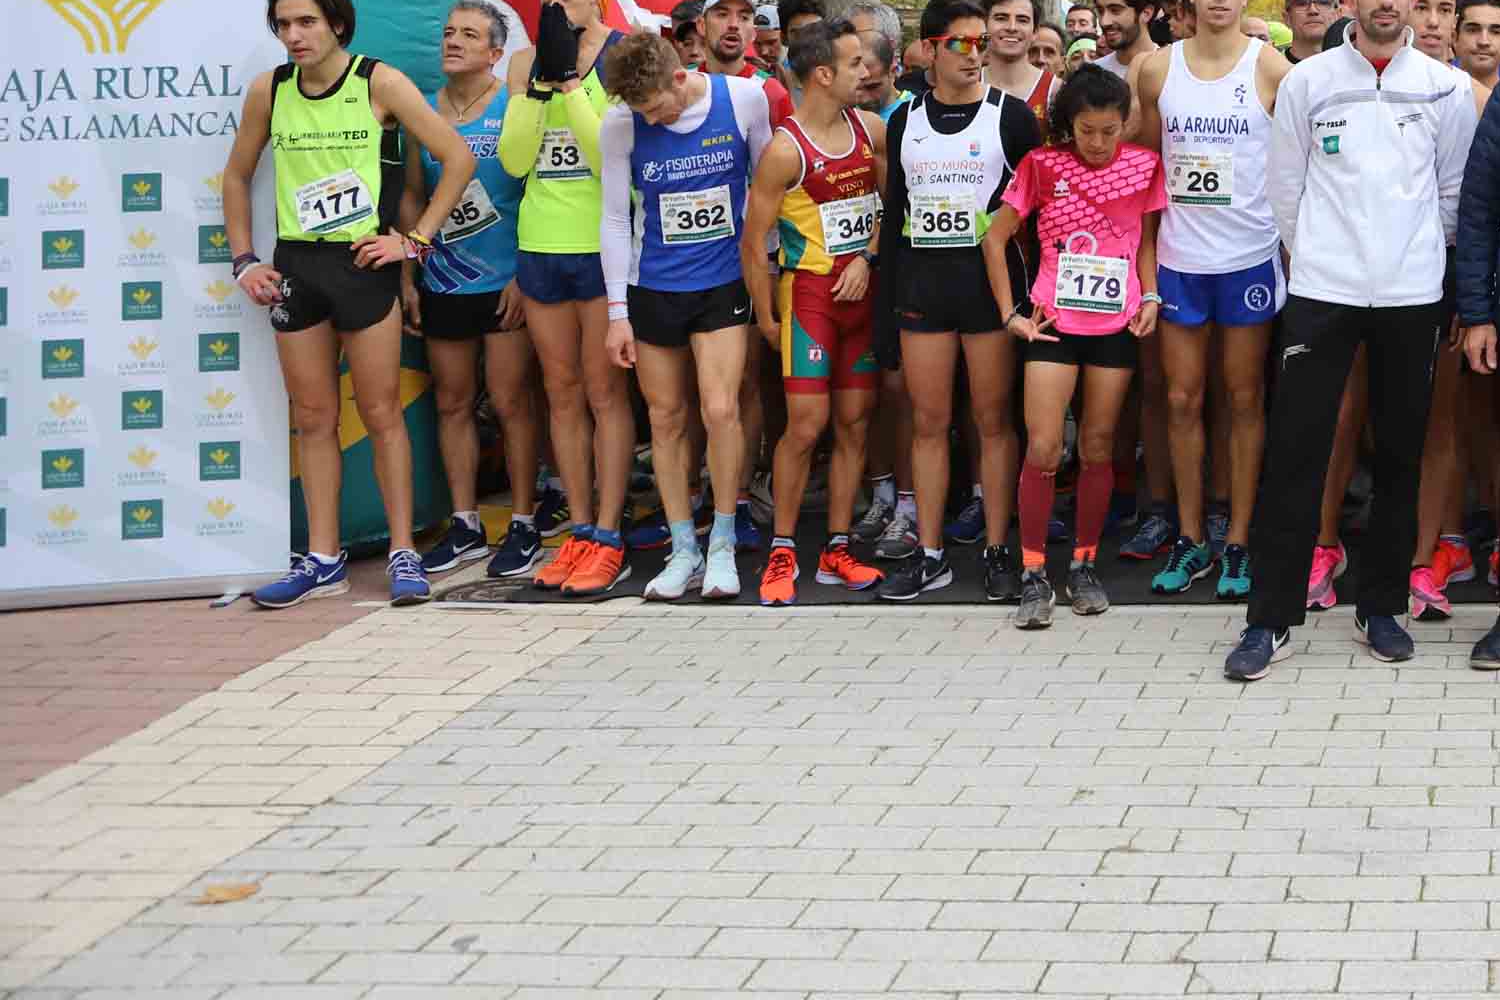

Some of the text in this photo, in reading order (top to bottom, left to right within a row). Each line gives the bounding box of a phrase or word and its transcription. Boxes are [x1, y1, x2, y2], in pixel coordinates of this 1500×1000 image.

[0, 63, 243, 112] AJA RURAL
[19, 110, 239, 142] SALAMANCA
[342, 130, 369, 140] TEO
[1166, 114, 1249, 135] LA ARMUÑA
[551, 145, 580, 167] 53
[665, 149, 734, 172] FISIOTERAPIA
[929, 174, 984, 185] SANTINOS
[1187, 171, 1219, 193] 26
[313, 186, 360, 220] 177
[450, 200, 481, 227] 95
[677, 204, 726, 230] 362
[838, 212, 873, 239] 346
[922, 210, 970, 233] 365
[1073, 273, 1121, 299] 179
